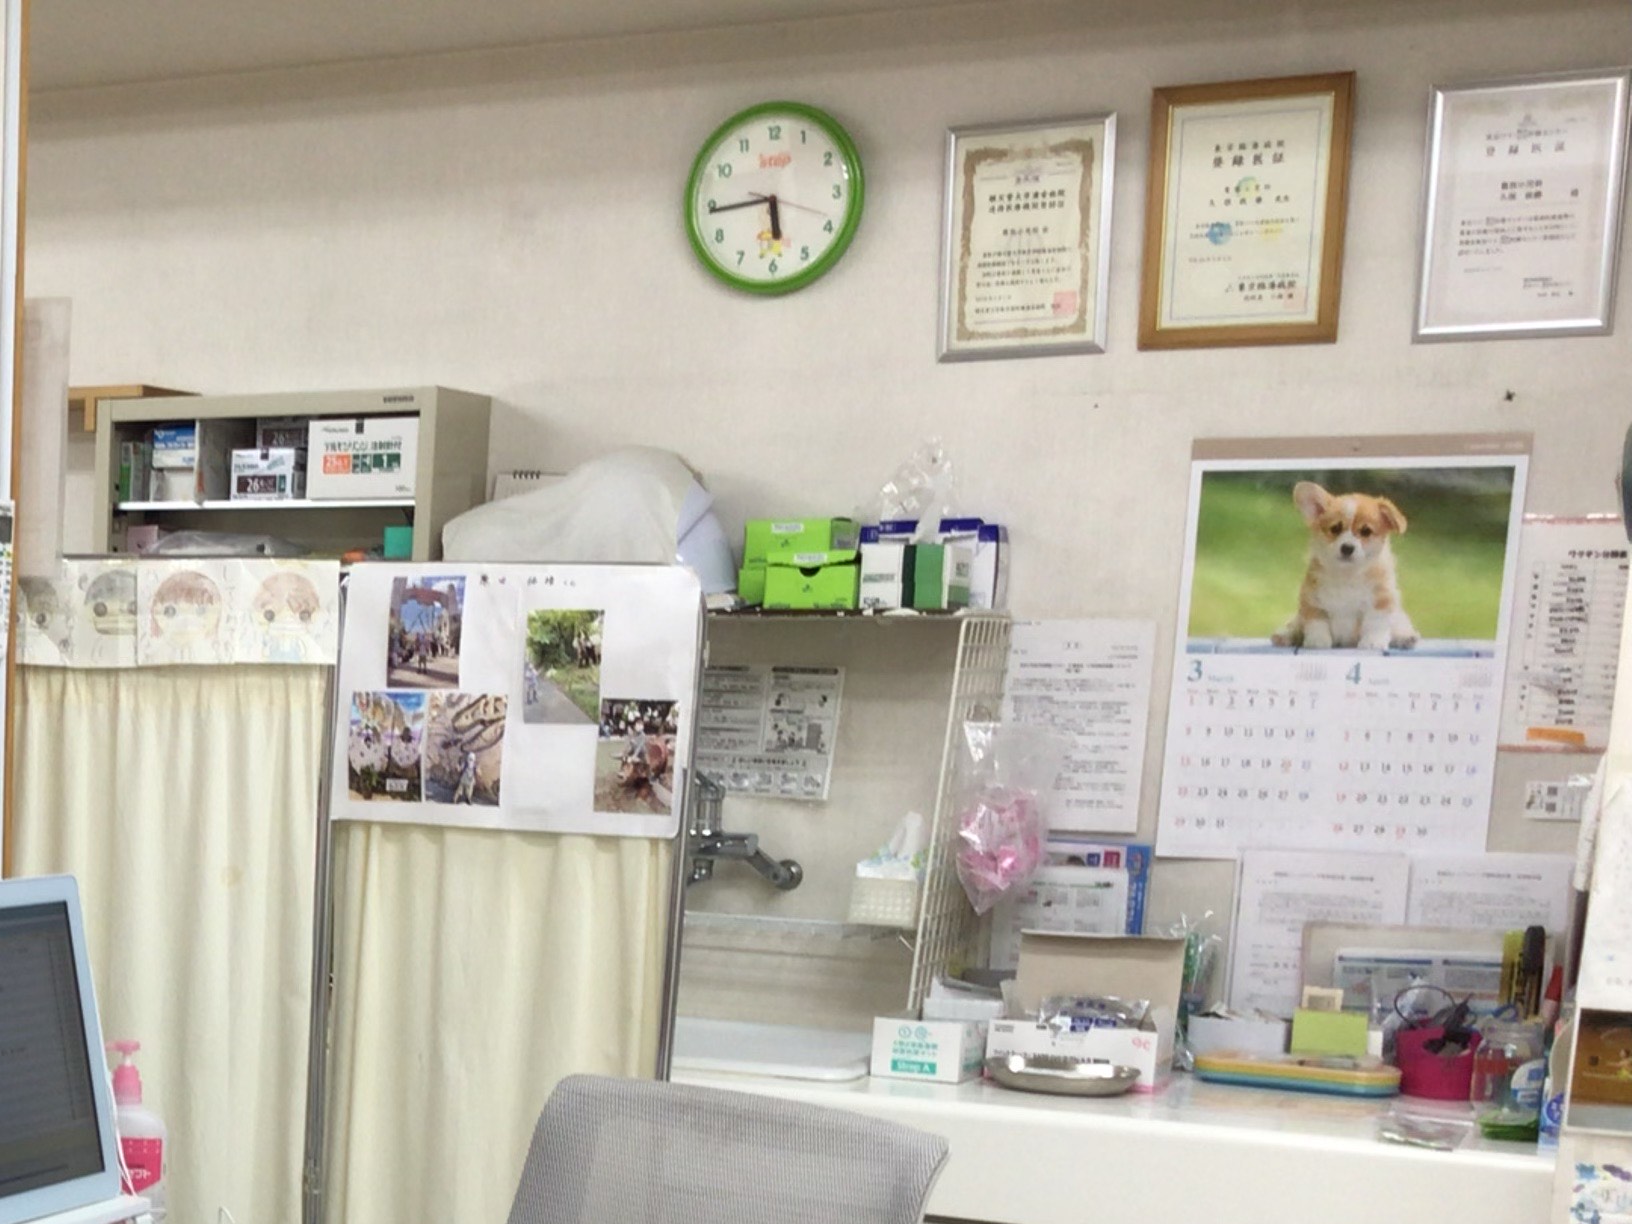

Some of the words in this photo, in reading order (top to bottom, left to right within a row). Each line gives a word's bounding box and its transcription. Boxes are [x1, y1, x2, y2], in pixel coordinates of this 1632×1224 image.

[768, 125, 782, 141] 12
[801, 129, 807, 144] 1
[739, 138, 750, 154] 11
[823, 151, 833, 167] 2
[717, 163, 733, 178] 10
[832, 184, 842, 199] 3
[823, 219, 834, 234] 4
[714, 228, 725, 243] 8
[736, 250, 746, 265] 7
[800, 246, 810, 261] 5
[768, 259, 778, 275] 6
[1186, 659, 1203, 683] 3
[1345, 662, 1361, 685] 4
